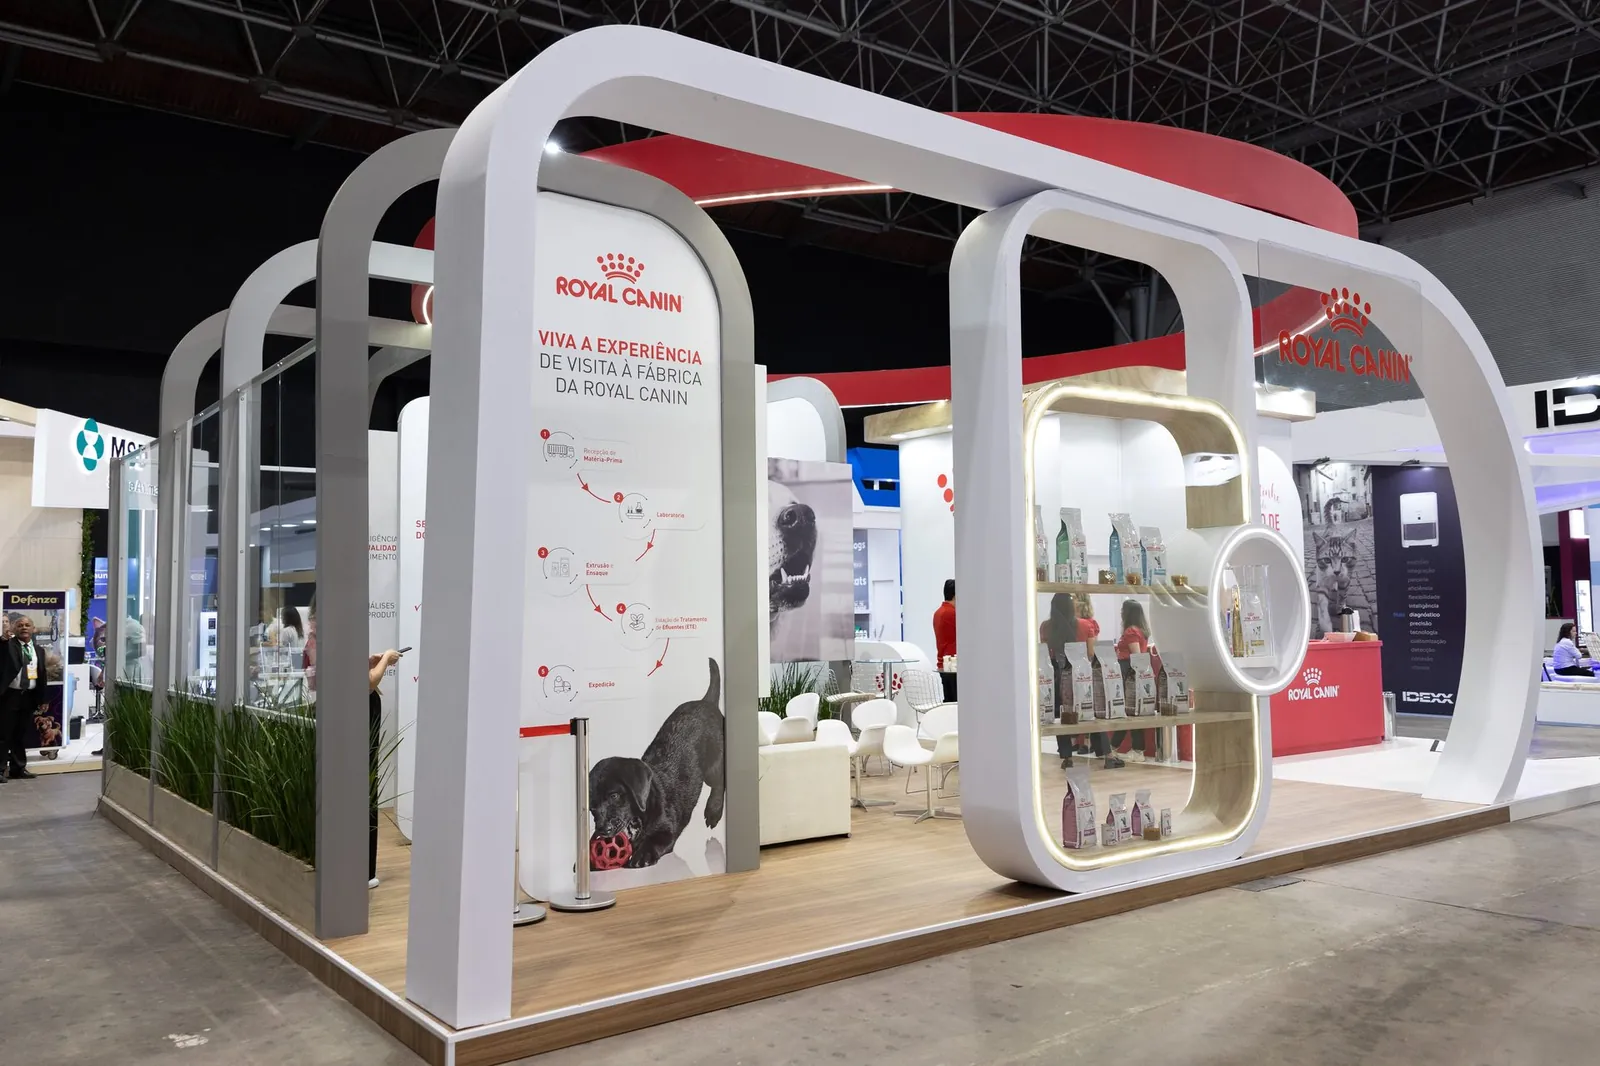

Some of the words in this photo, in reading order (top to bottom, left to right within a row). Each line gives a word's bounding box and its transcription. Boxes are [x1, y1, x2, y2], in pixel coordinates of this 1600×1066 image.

[556, 276, 618, 303] ROYAL
[622, 287, 682, 313] CANIN
[538, 330, 577, 350] VIVA
[580, 336, 593, 352] A
[597, 338, 702, 366] EXPERIÊNCIA
[1279, 329, 1346, 373] ROYAL
[1350, 344, 1411, 384] CANIN
[540, 353, 562, 370] DE
[567, 356, 618, 376] VISITA
[621, 359, 633, 378] À
[637, 362, 702, 386] FÁBRICA
[556, 377, 579, 395] DA
[584, 380, 635, 401] ROYAL
[639, 386, 688, 406] CANIN
[583, 455, 623, 464] Matéria-Prima
[368, 535, 397, 543] IGÊNCIA
[854, 542, 865, 551] ogs
[11, 595, 58, 606] Defenza
[1288, 687, 1313, 701] ROYAL
[1313, 685, 1338, 699] CANIN
[1402, 691, 1454, 704] IDEXX
